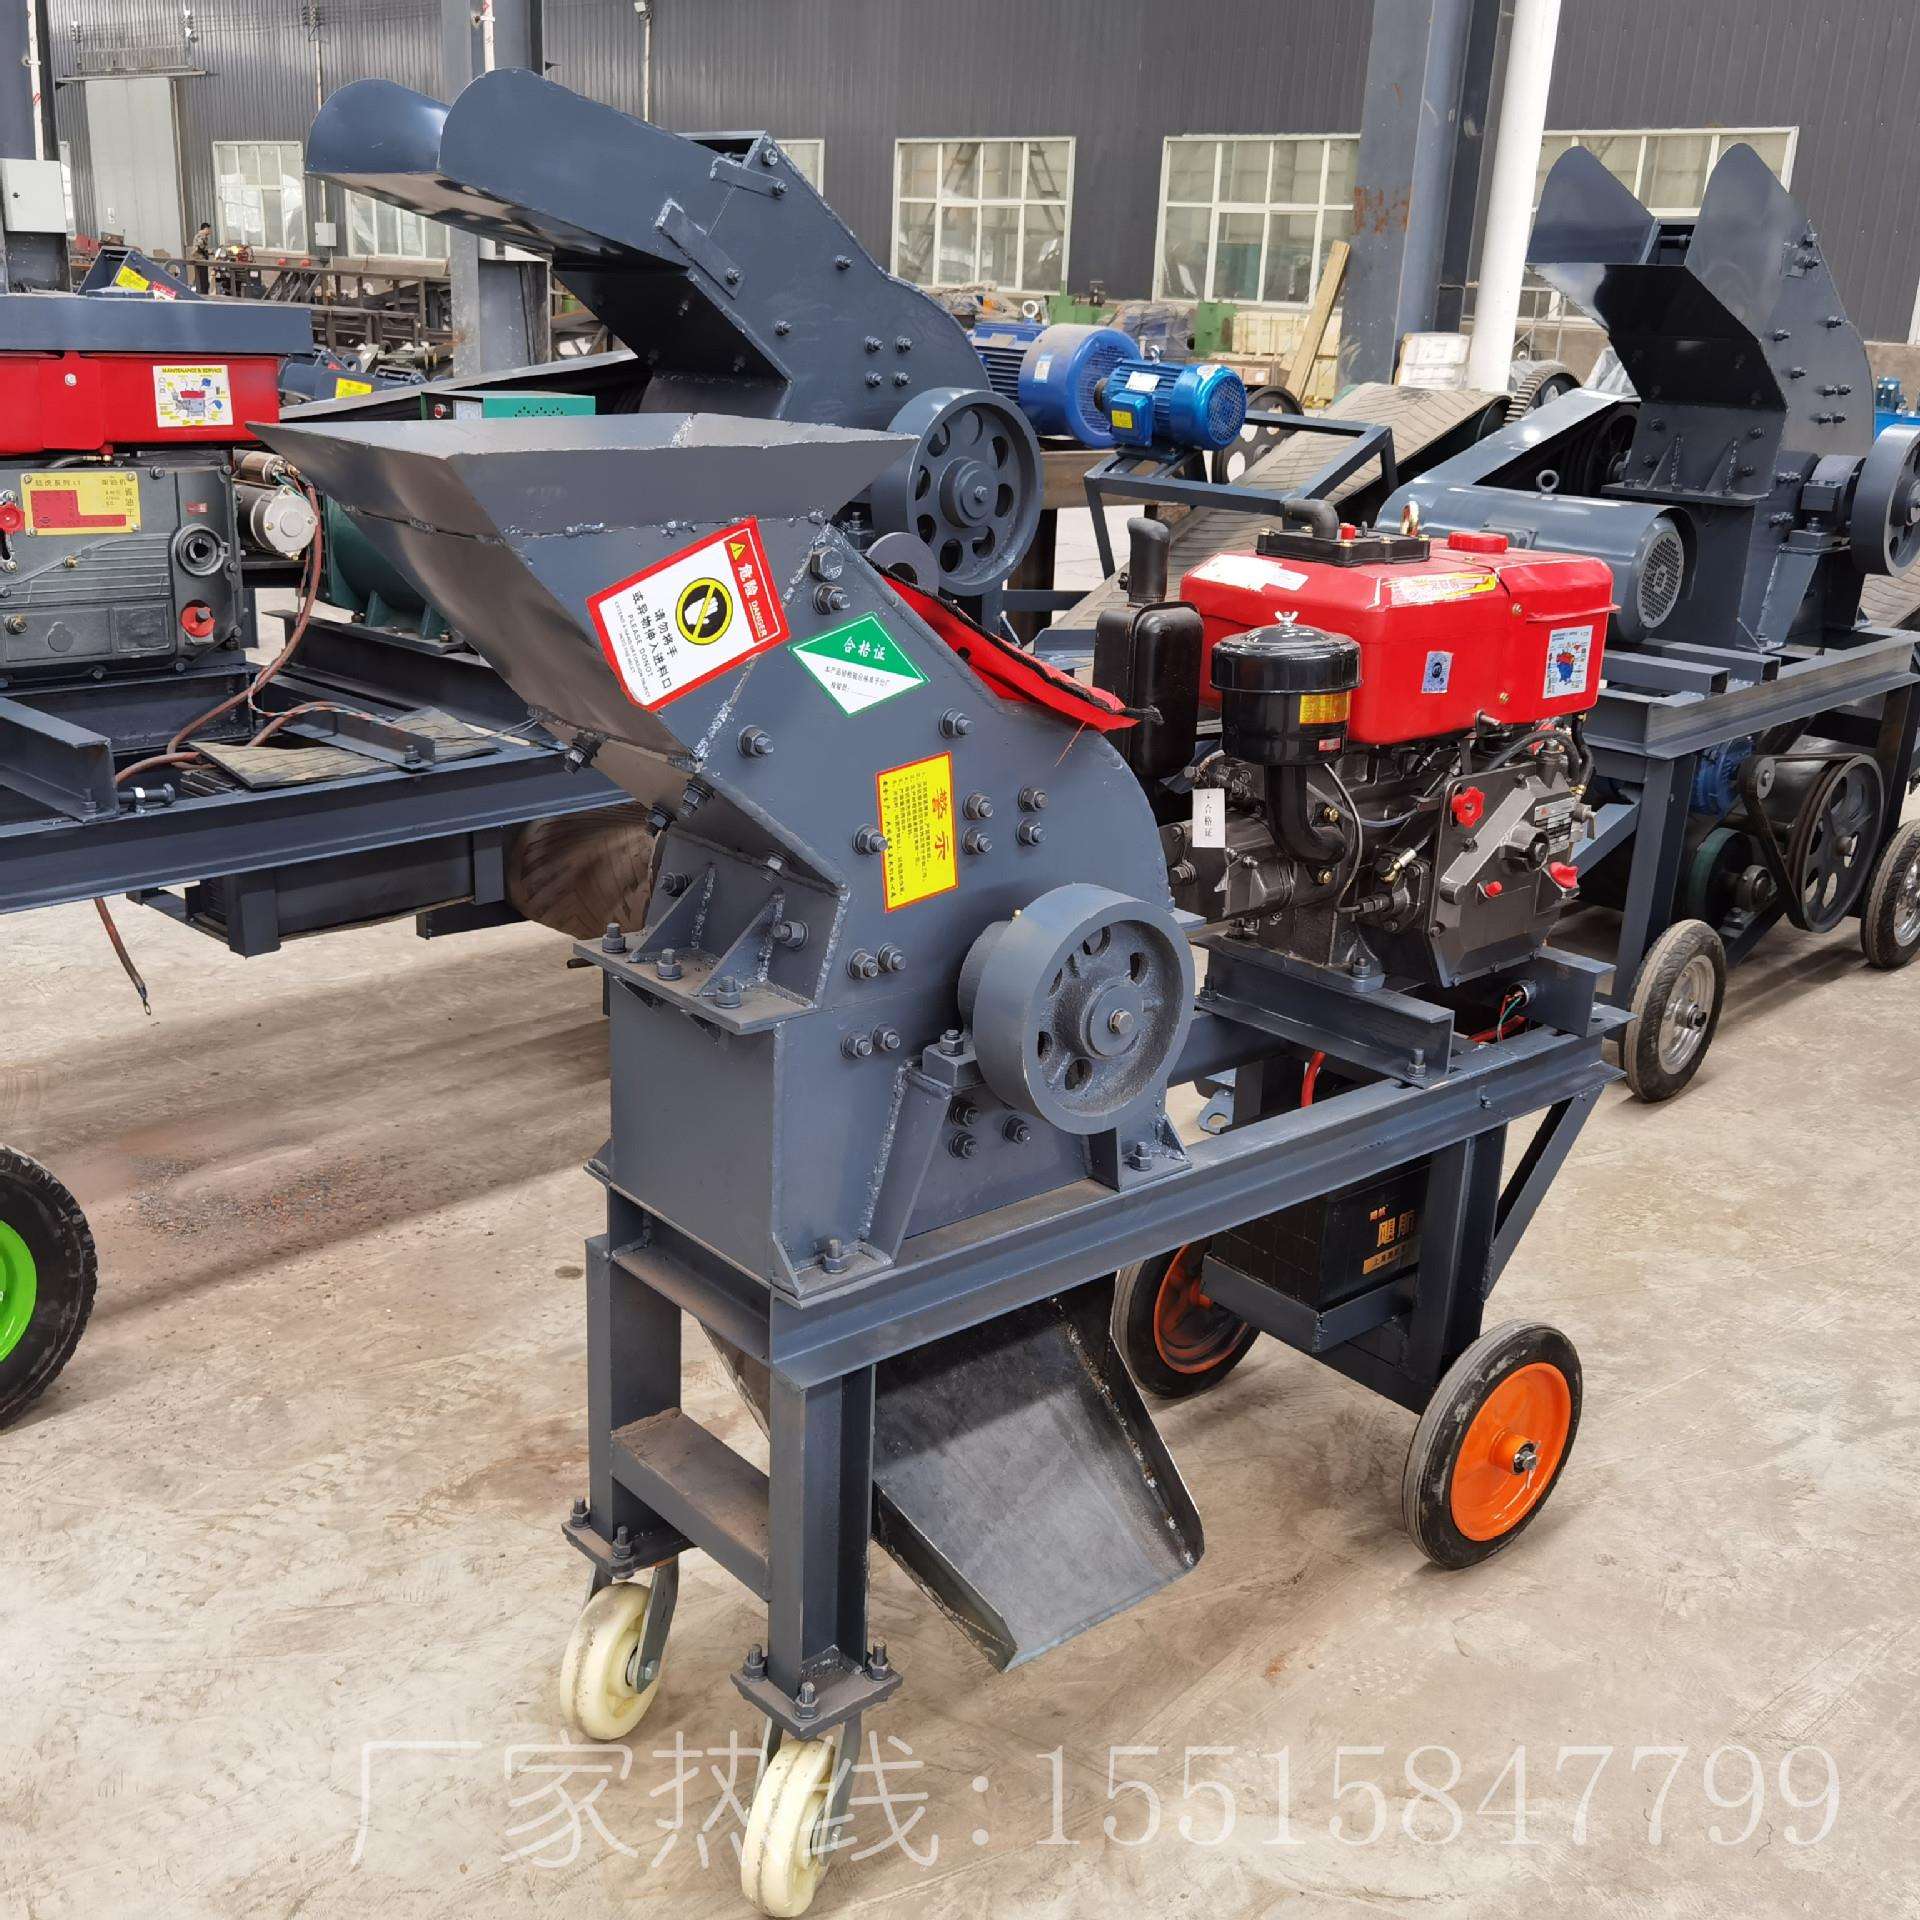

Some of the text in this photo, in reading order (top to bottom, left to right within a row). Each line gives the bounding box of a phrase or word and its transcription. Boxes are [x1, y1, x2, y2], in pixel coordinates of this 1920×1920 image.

[738, 563, 758, 598] 危险
[627, 614, 642, 645] PLEASE
[654, 608, 677, 658] 请勿将手
[751, 599, 767, 637] DANGER
[632, 591, 672, 689] 或异物伸入进料口
[843, 636, 886, 661] 合格证
[931, 786, 949, 861] 警示
